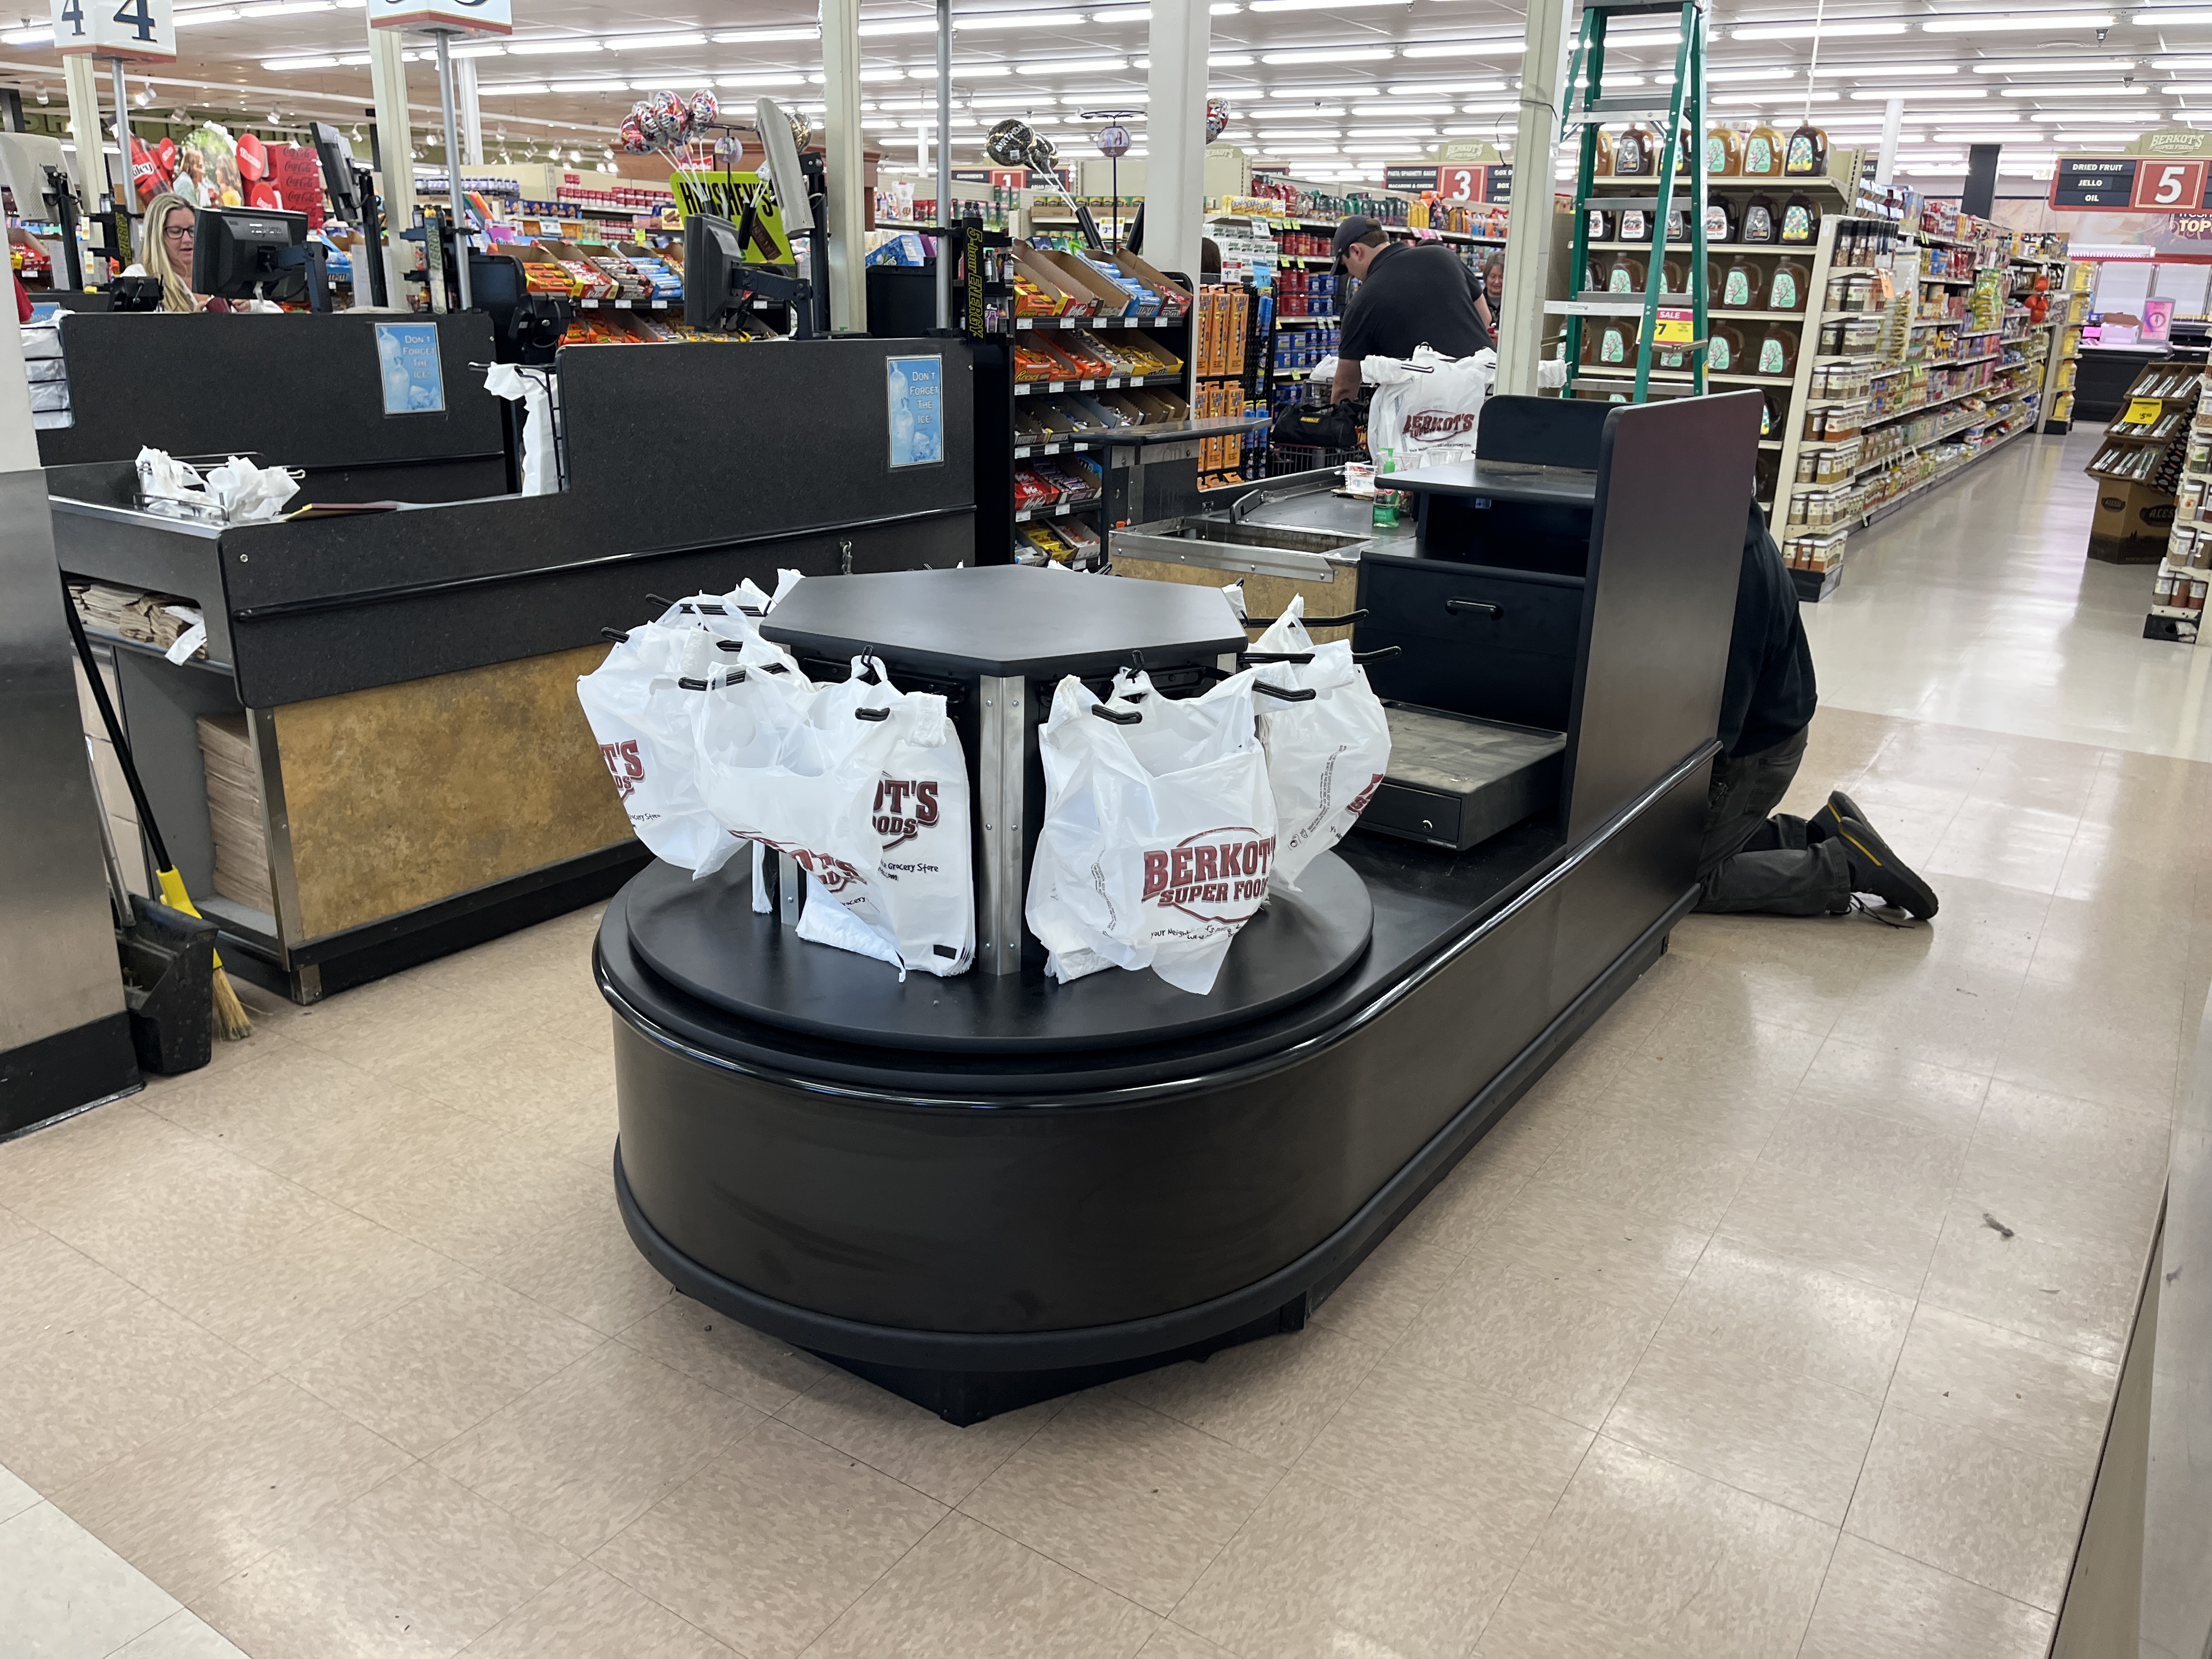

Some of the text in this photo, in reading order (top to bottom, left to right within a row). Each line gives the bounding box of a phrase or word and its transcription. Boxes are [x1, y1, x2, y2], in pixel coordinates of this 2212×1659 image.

[62, 0, 84, 36] 4
[114, 0, 157, 42] 4
[2150, 134, 2205, 150] BERKOT'S
[1446, 144, 1483, 156] BERKOT'S
[1002, 174, 1012, 187] 1
[1452, 170, 1472, 201] 3
[2154, 166, 2185, 204] 5
[967, 227, 984, 338] 5-hour ENERGY
[1659, 311, 1680, 319] SALE
[404, 335, 431, 344] DON'T
[403, 347, 435, 356] FORGET
[413, 359, 429, 367] THE
[912, 371, 936, 381] DON'T
[910, 386, 939, 396] FORGET
[917, 400, 933, 409] THE
[872, 815, 917, 835] ODS
[888, 862, 916, 872] Grocery
[917, 862, 939, 873] Store
[1142, 834, 1276, 903] BERKOT'
[1159, 882, 1229, 904] SUPER
